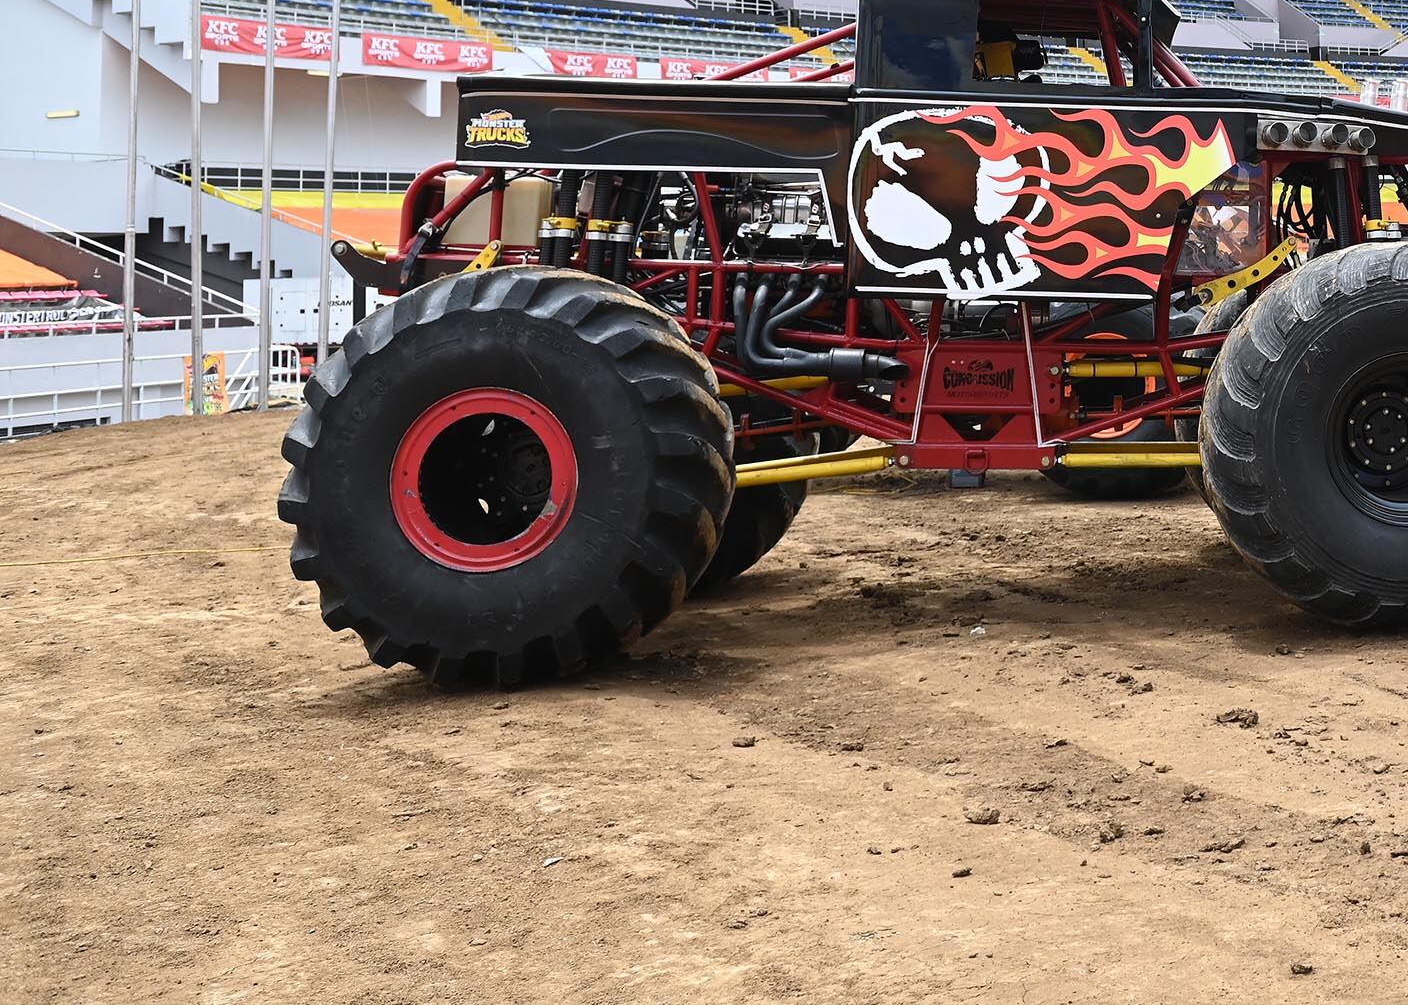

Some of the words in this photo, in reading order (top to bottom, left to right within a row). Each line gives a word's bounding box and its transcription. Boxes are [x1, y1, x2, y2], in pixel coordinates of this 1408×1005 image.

[207, 20, 238, 35] KFC
[256, 25, 286, 40] KC
[303, 30, 332, 44] KFC
[371, 37, 399, 51] KFC
[415, 41, 443, 55] KFC
[460, 46, 486, 58] KFC
[567, 55, 592, 68] KFC
[606, 57, 632, 70] KFC
[667, 62, 691, 73] KFC
[471, 118, 526, 128] MONSTER
[469, 126, 527, 144] TRUCKS
[943, 366, 1015, 392] CONCUSSION
